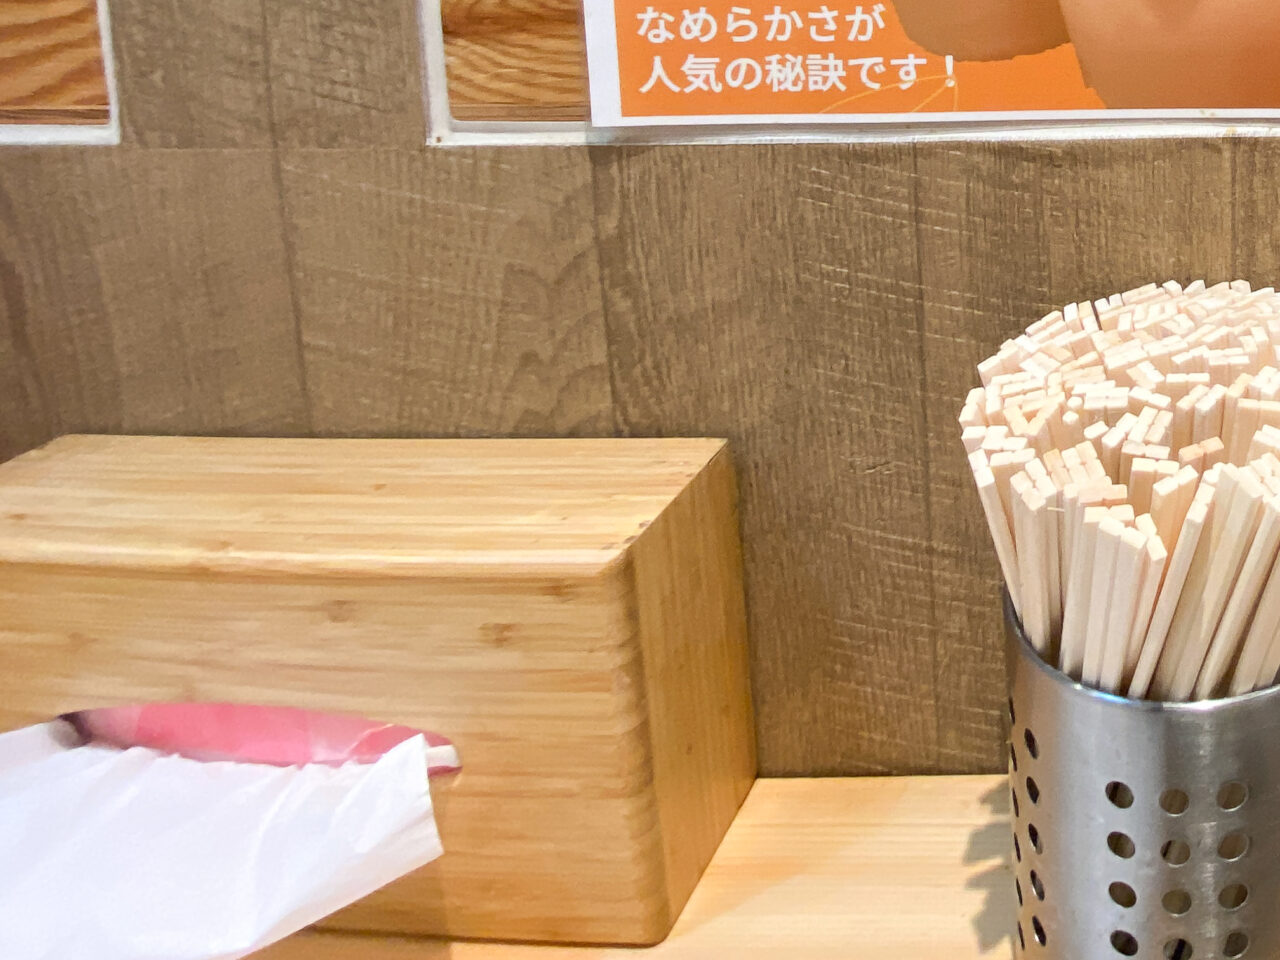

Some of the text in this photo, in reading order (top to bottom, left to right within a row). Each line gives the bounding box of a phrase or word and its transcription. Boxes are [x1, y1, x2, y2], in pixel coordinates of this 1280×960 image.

[635, 3, 887, 45] なめらかさが
